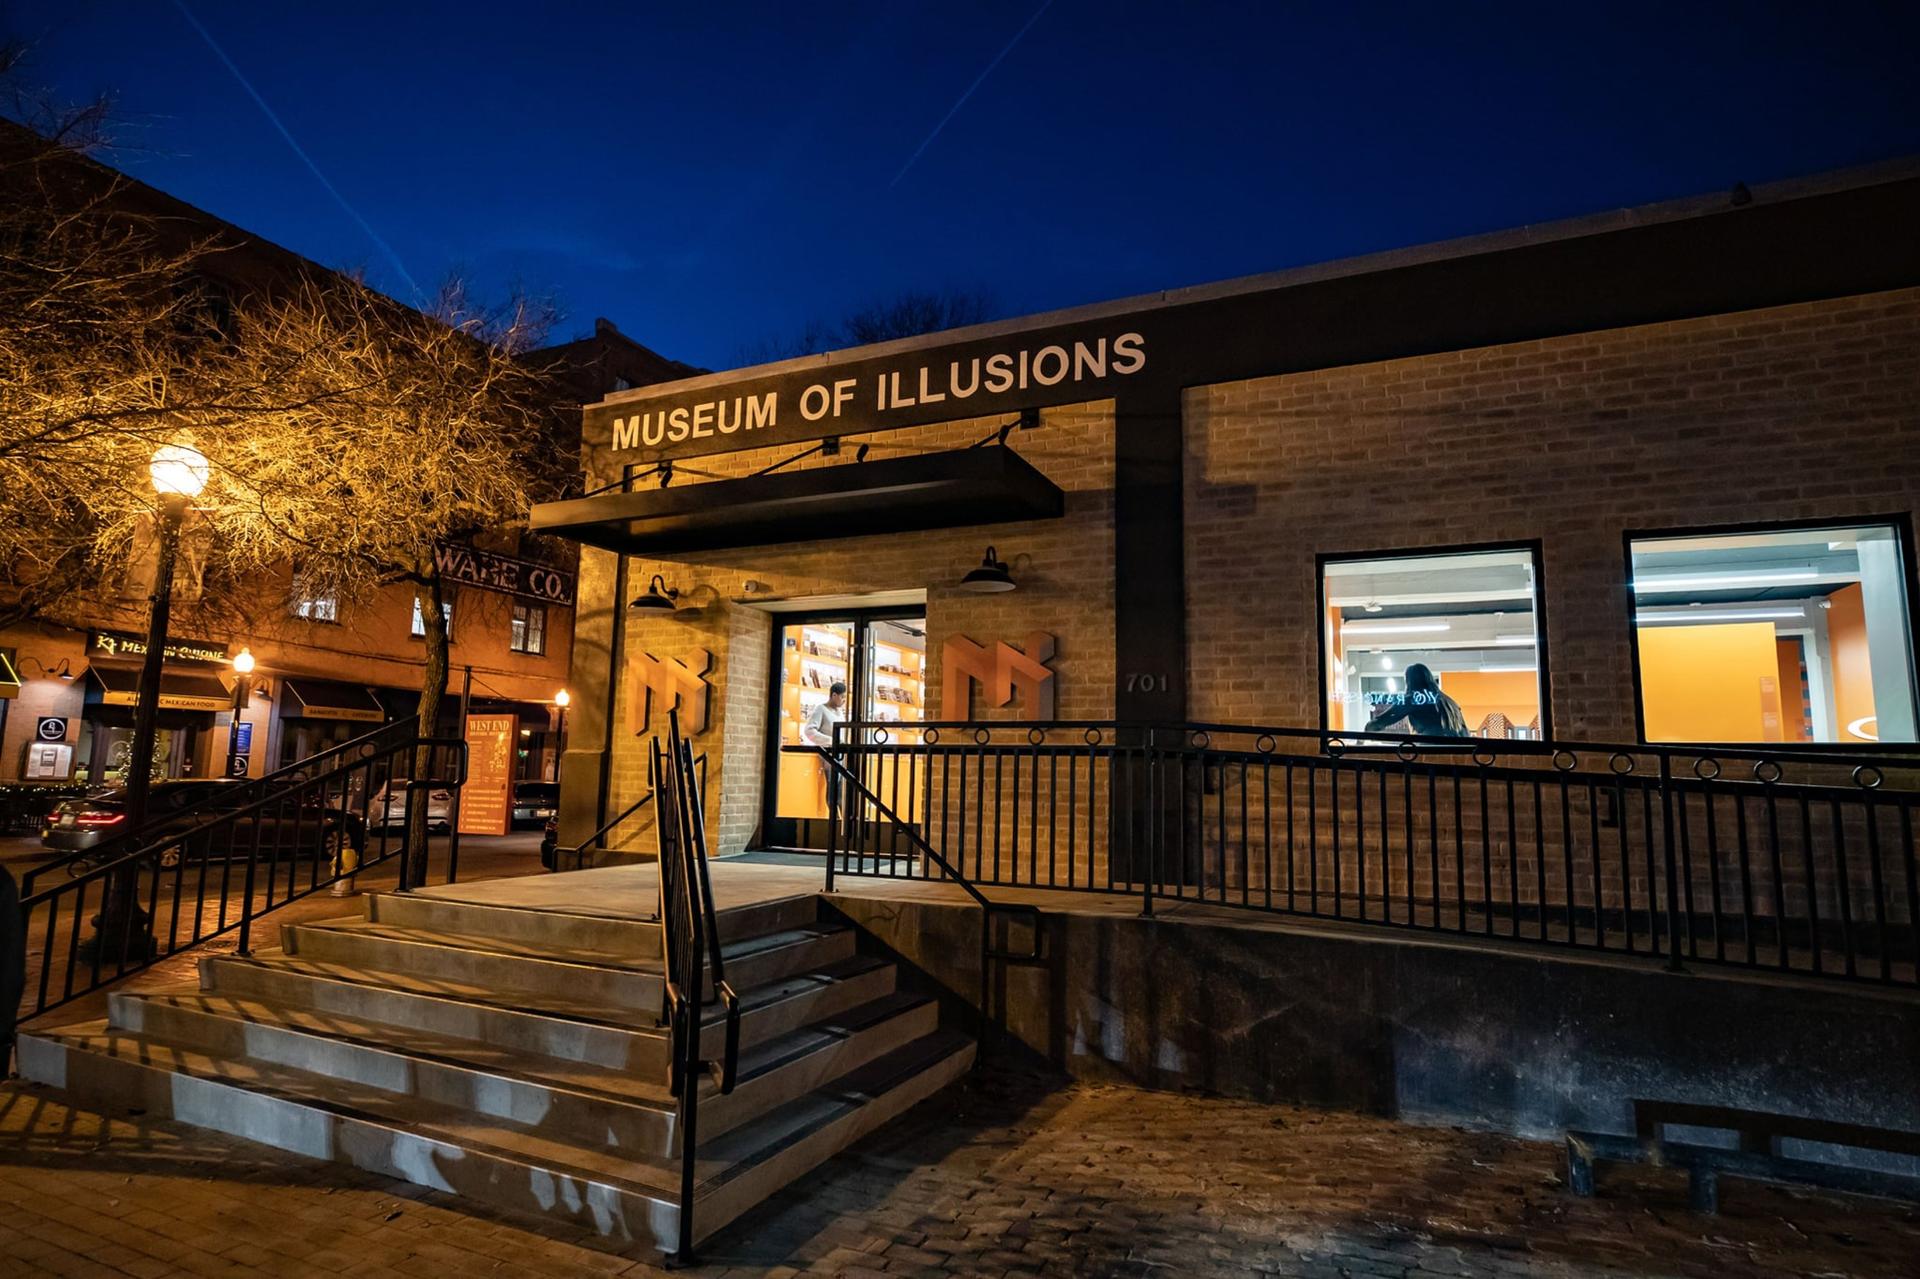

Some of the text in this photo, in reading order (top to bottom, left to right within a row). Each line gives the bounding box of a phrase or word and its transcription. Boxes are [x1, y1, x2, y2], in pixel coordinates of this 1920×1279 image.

[611, 332, 1146, 451] MUSEUM OF ILLUSIONS
[528, 569, 566, 600] CO.
[1125, 673, 1167, 693] 701
[165, 699, 196, 707] MEXICAN
[469, 720, 510, 731] WEST END
